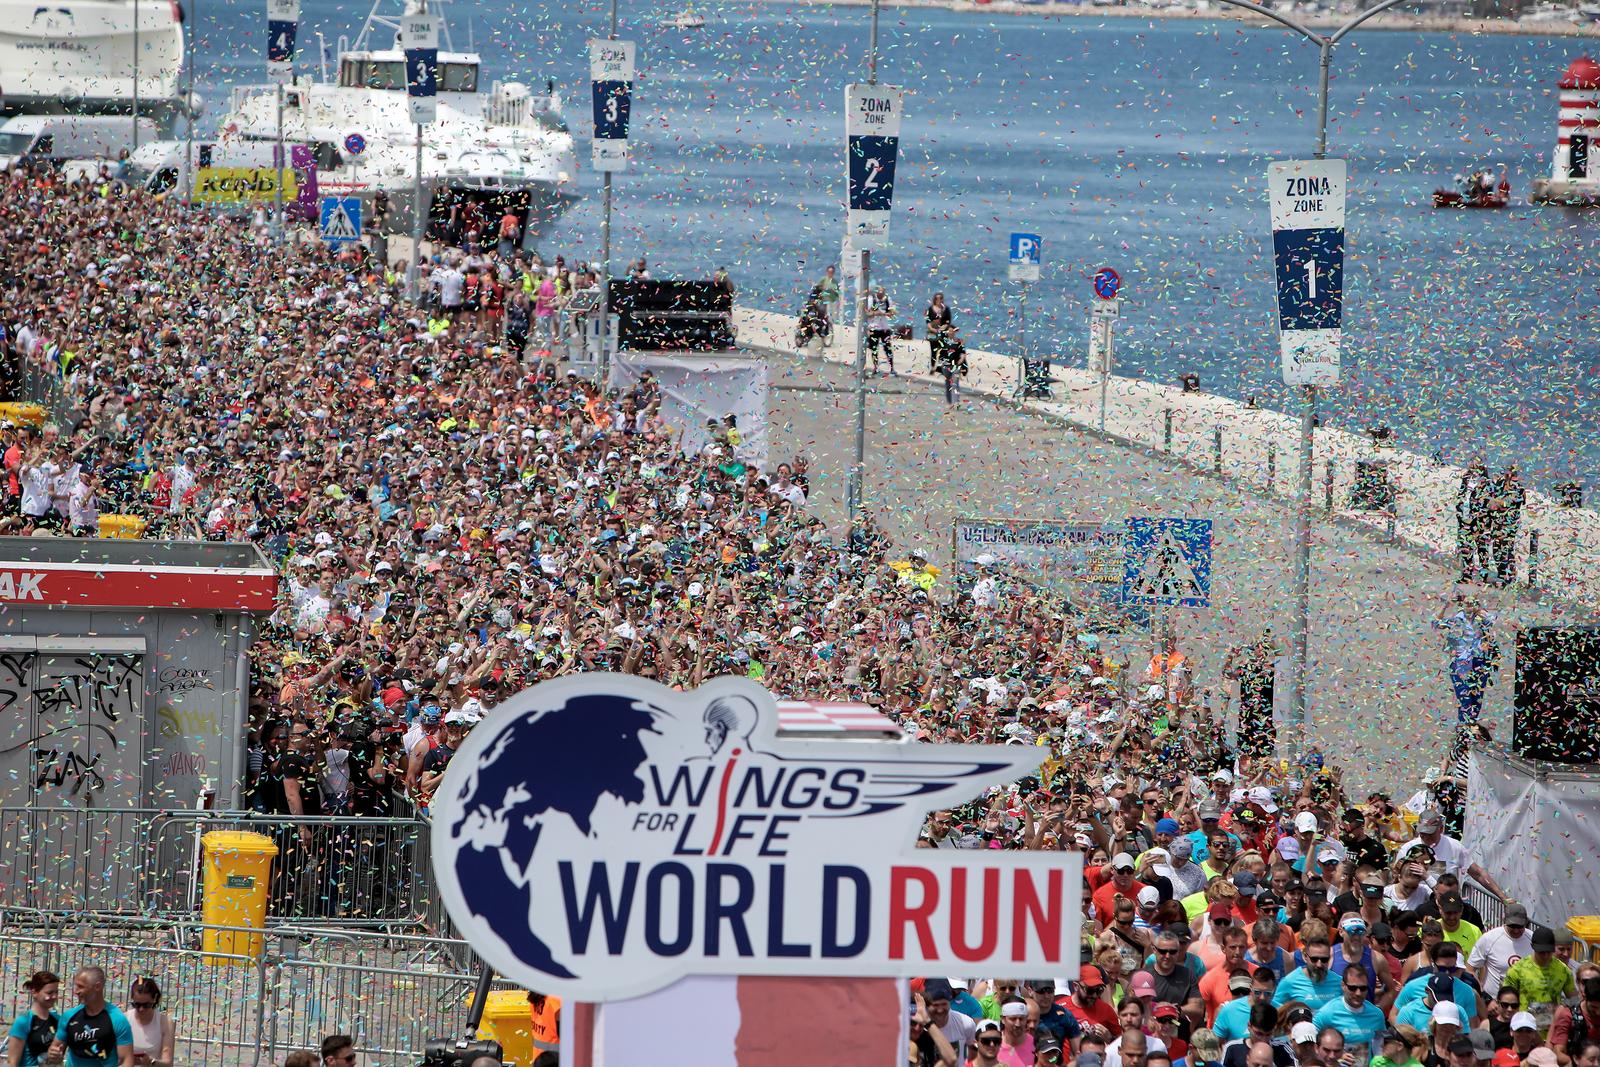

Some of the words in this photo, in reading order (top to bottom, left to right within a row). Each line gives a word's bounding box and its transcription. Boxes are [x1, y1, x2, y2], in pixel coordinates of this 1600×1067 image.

[410, 24, 431, 33] ZONA
[276, 32, 287, 49] 4
[600, 50, 626, 61] ZONA
[417, 62, 427, 83] 3
[606, 98, 617, 122] 3
[861, 98, 891, 112] ZONA
[865, 115, 885, 124] ZONE
[865, 158, 880, 188] 2
[1287, 178, 1330, 196] ZONA
[1294, 200, 1323, 212] ZONE
[1018, 238, 1033, 258] P
[1304, 260, 1316, 298] 1
[632, 813, 678, 831] FOR
[673, 813, 801, 856] LIFE
[558, 861, 871, 957] WORLD
[888, 865, 1063, 963] RUN
